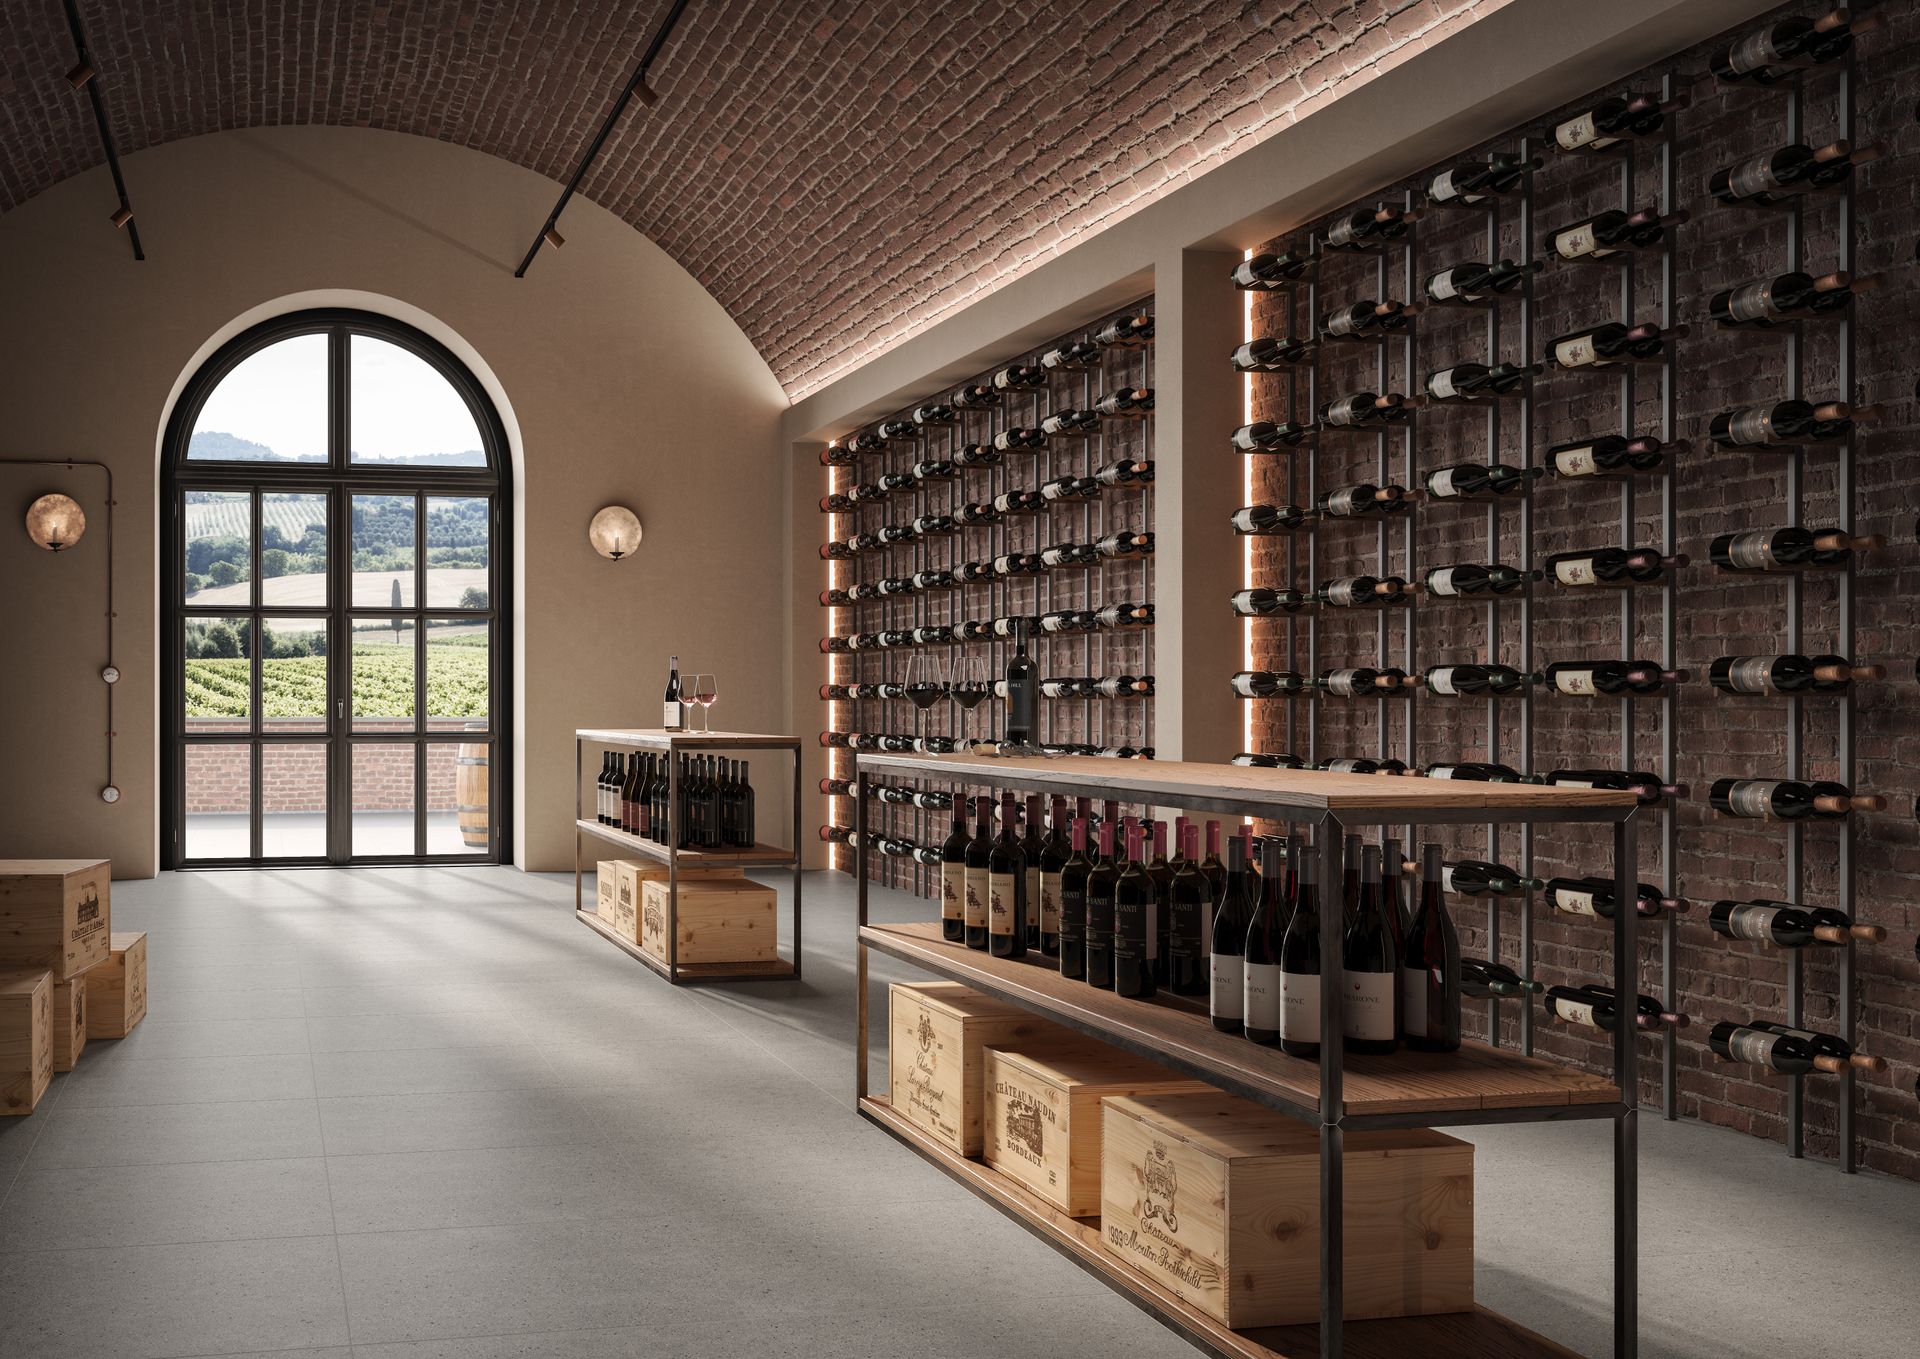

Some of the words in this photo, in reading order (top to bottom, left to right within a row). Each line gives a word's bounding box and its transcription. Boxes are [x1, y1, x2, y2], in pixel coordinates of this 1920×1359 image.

[995, 1081, 1027, 1103] CHÂTEAU
[1028, 1094, 1057, 1124] NAUDIN
[1007, 1140, 1042, 1168] BORDEAUX
[1123, 1229, 1158, 1264] Mouton
